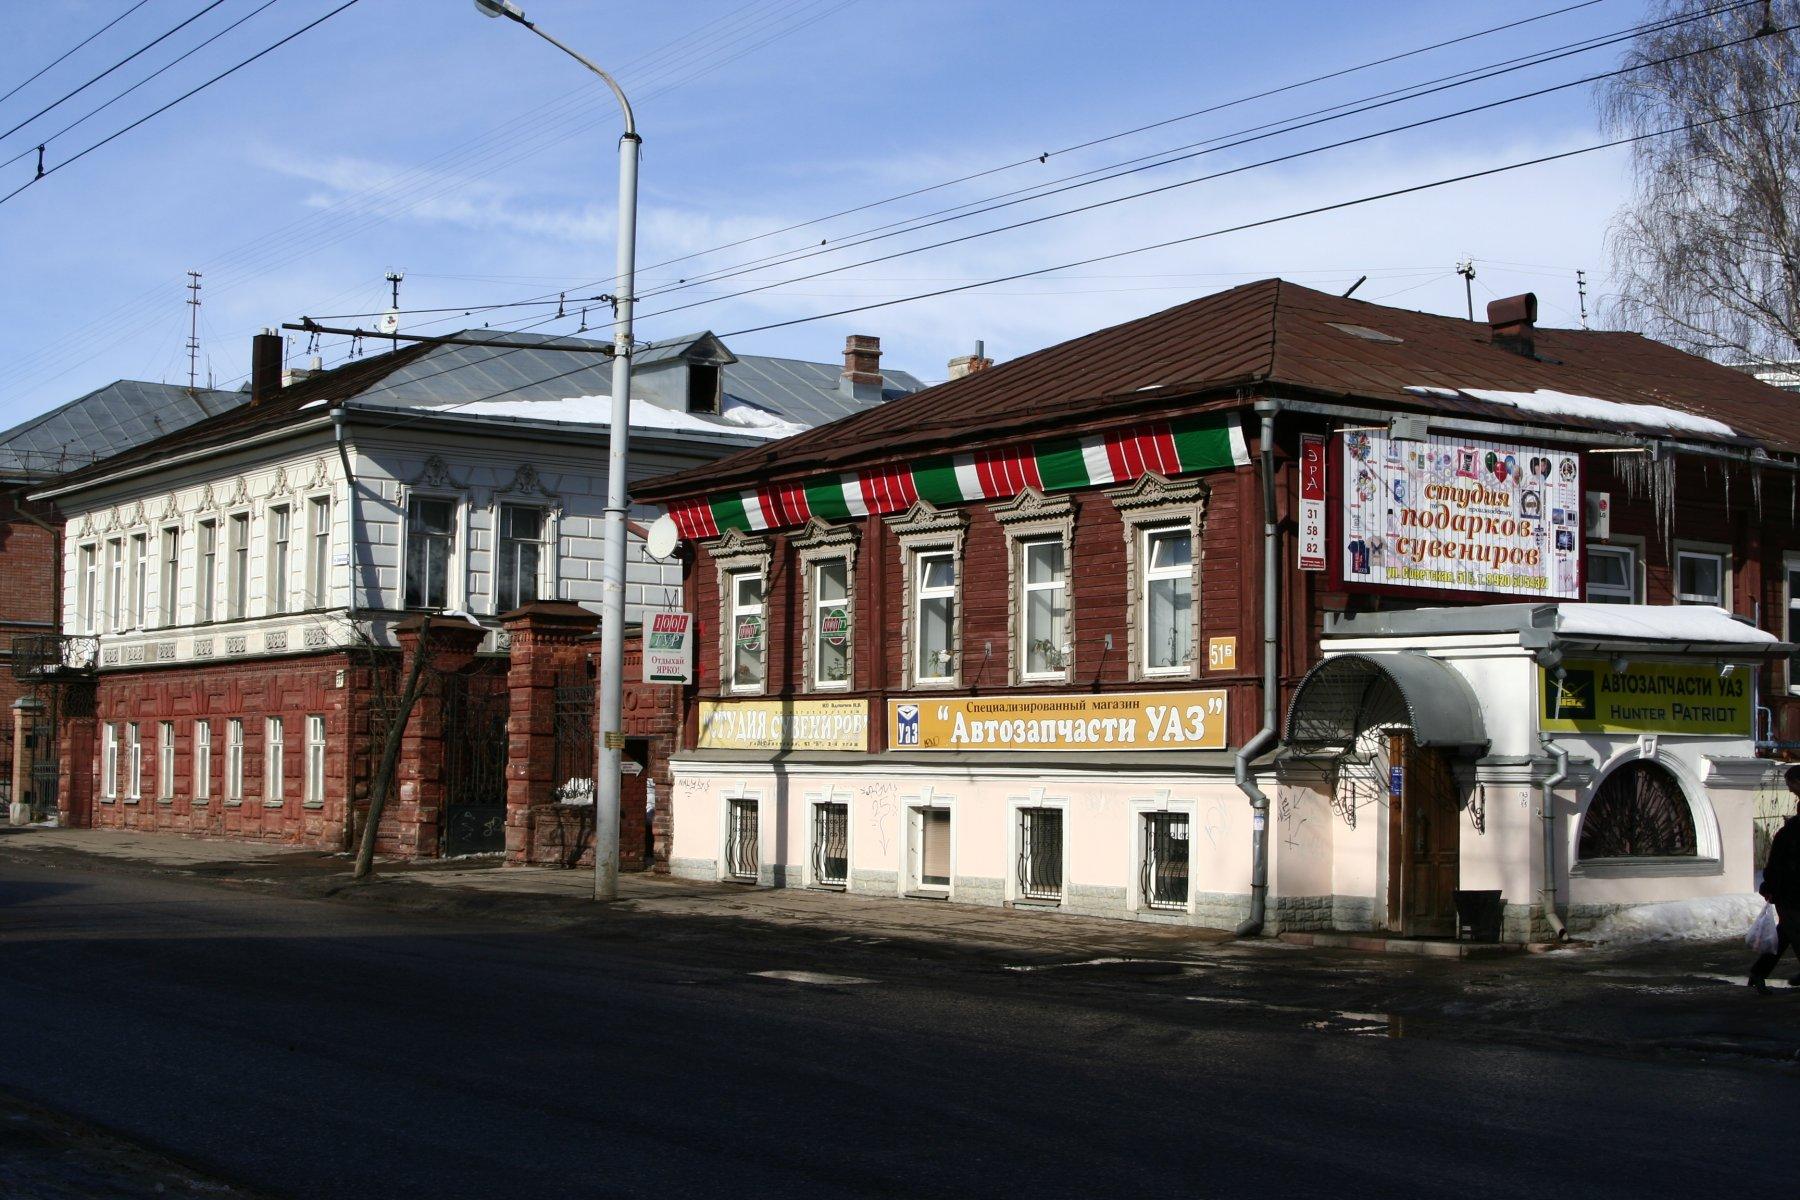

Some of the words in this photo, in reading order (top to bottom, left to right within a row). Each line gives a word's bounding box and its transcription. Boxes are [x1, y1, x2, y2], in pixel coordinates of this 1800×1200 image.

[1306, 449, 1318, 491] ЭРА
[1424, 481, 1510, 509] студия
[1307, 509, 1318, 519] 31
[1306, 525, 1318, 536] 58
[1306, 543, 1318, 553] 82
[1396, 537, 1539, 569] сувениров
[655, 615, 686, 630] 1001
[655, 633, 680, 647] ТУР
[651, 656, 686, 665] Отдыхай
[656, 665, 680, 675] ЯРКО!
[1601, 673, 1712, 696] АВТОЗАПЧАСТИ
[1718, 677, 1743, 697] УАЗ
[966, 700, 1086, 714] Специализированный
[1092, 700, 1140, 710] магазин
[1611, 704, 1665, 721] HUNTER
[1672, 702, 1737, 722] PATRIOT
